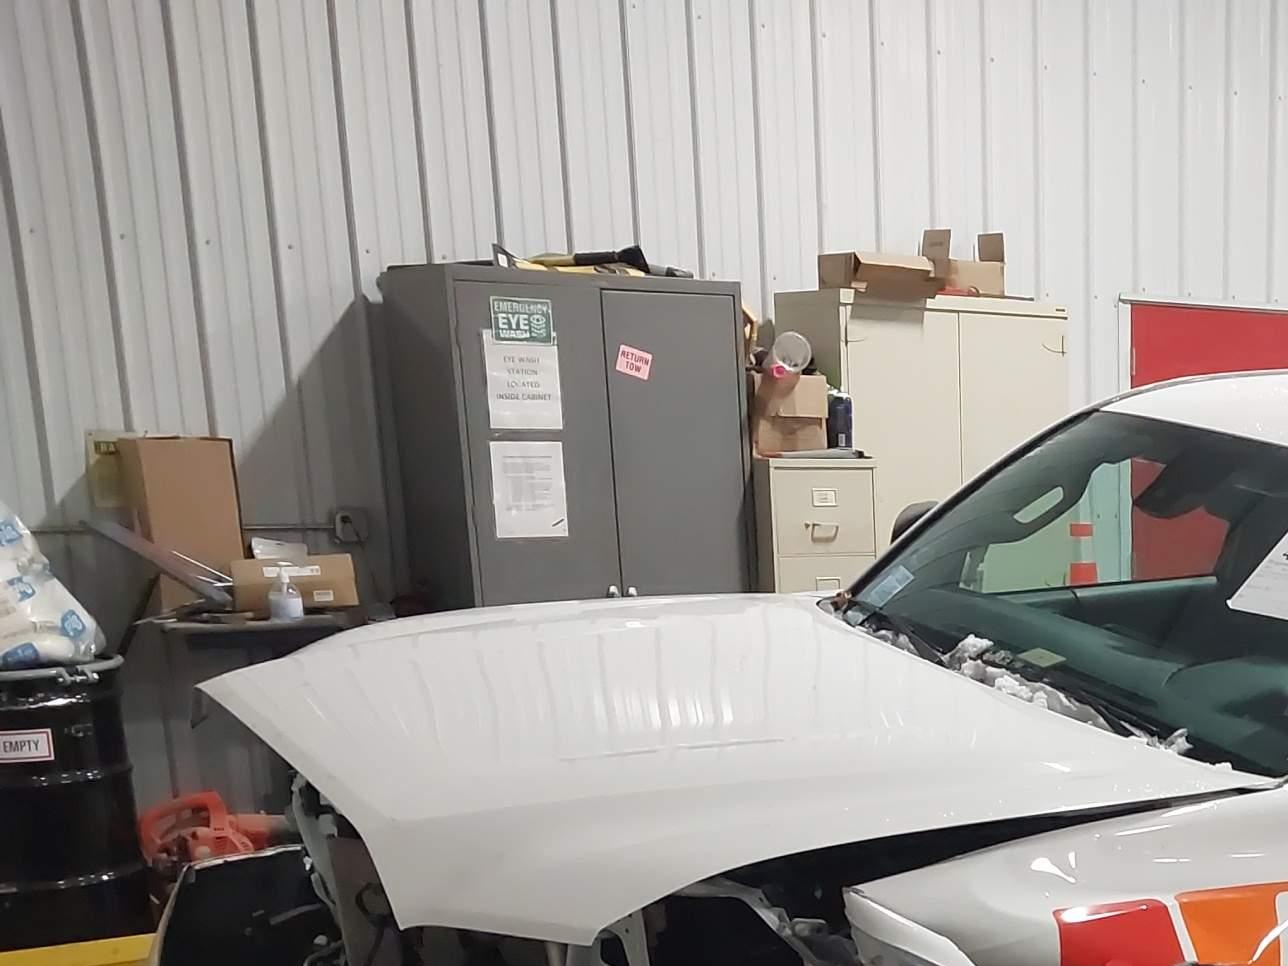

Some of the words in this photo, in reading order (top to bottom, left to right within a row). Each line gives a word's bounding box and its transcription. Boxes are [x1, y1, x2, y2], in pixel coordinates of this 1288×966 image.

[494, 300, 548, 314] EMERGENCY
[498, 313, 529, 330] EYE
[499, 329, 531, 338] WASH
[503, 355, 516, 364] EYE
[621, 350, 650, 366] RETURN
[507, 368, 538, 376] STATION
[625, 360, 642, 373] TOW
[496, 392, 520, 401] INSIDE
[522, 393, 552, 402] CABINET
[3, 739, 40, 753] EMPTY
